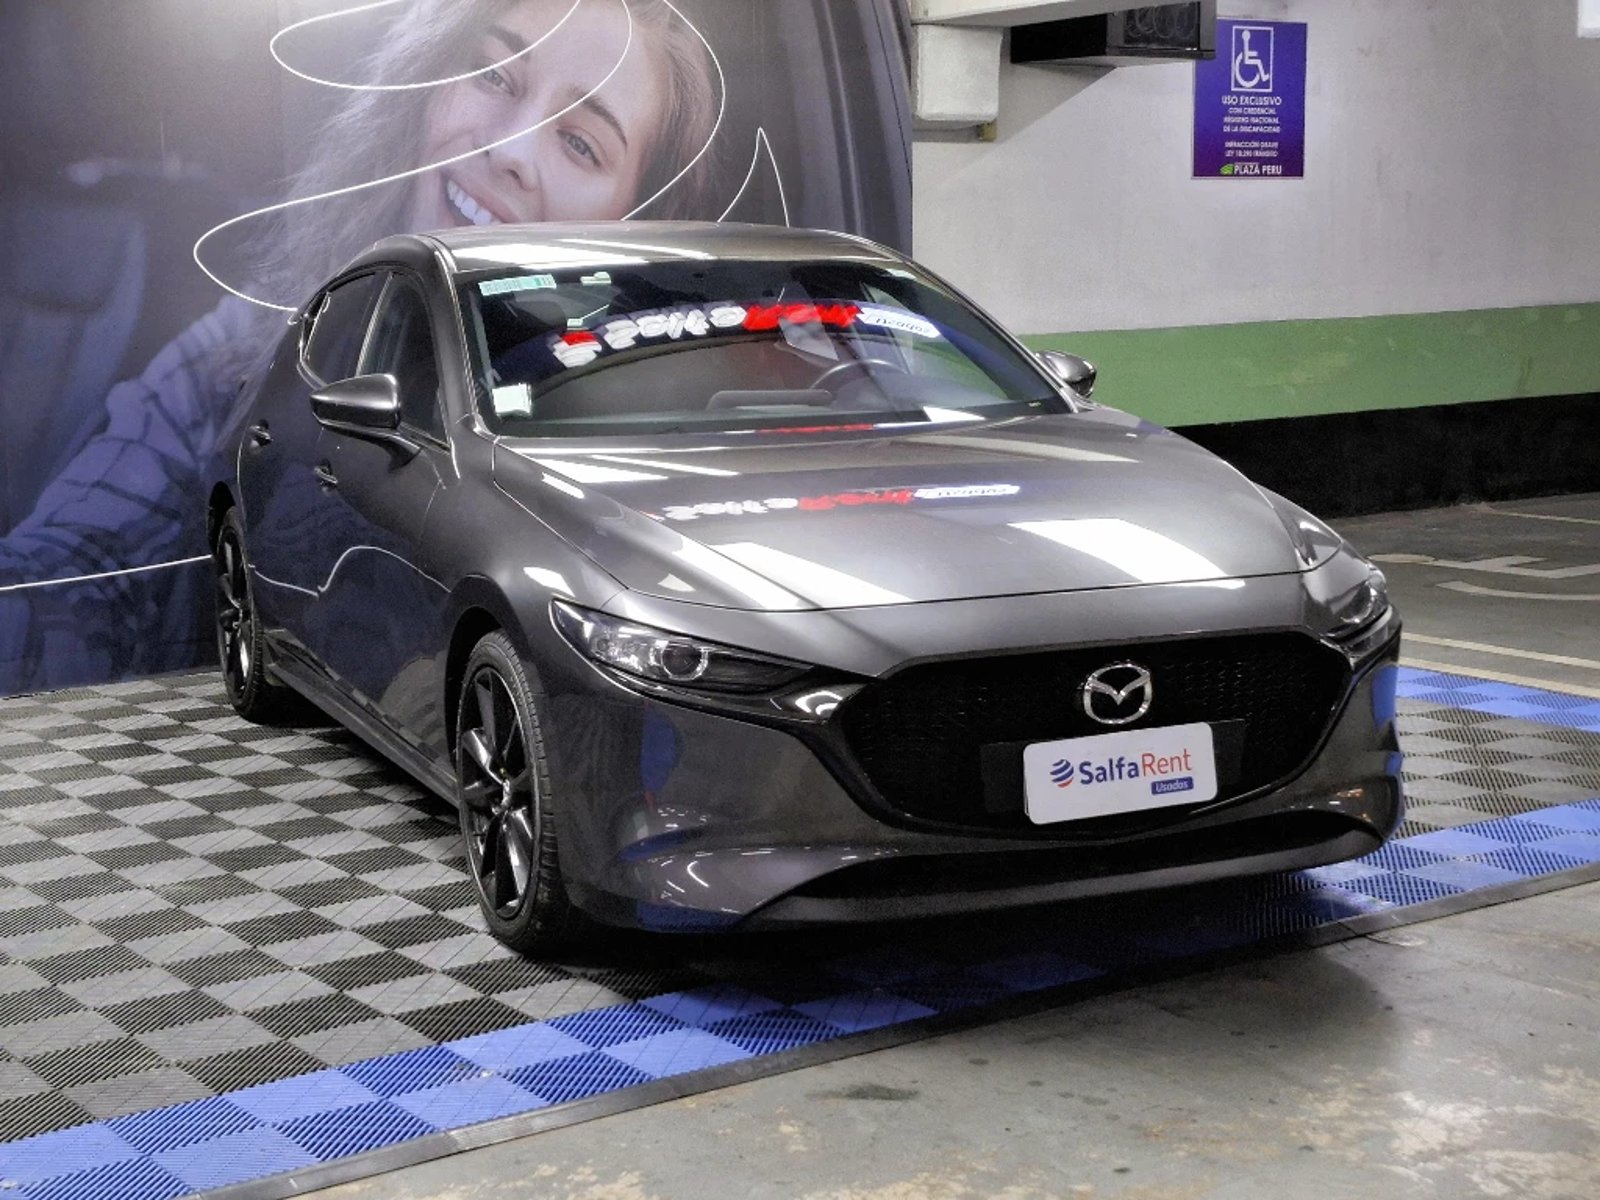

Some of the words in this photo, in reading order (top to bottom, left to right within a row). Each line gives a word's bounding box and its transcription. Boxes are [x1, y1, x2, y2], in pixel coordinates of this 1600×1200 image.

[1221, 95, 1238, 105] USO
[1240, 96, 1282, 106] EXCLUSIVO
[1243, 107, 1277, 115] CREDENCIAL
[1250, 116, 1279, 124] NACIONAL
[1234, 164, 1260, 175] PLAZA
[1261, 165, 1282, 175] PERU
[1079, 749, 1193, 785] SalfaRent
[1155, 779, 1190, 793] Usados
